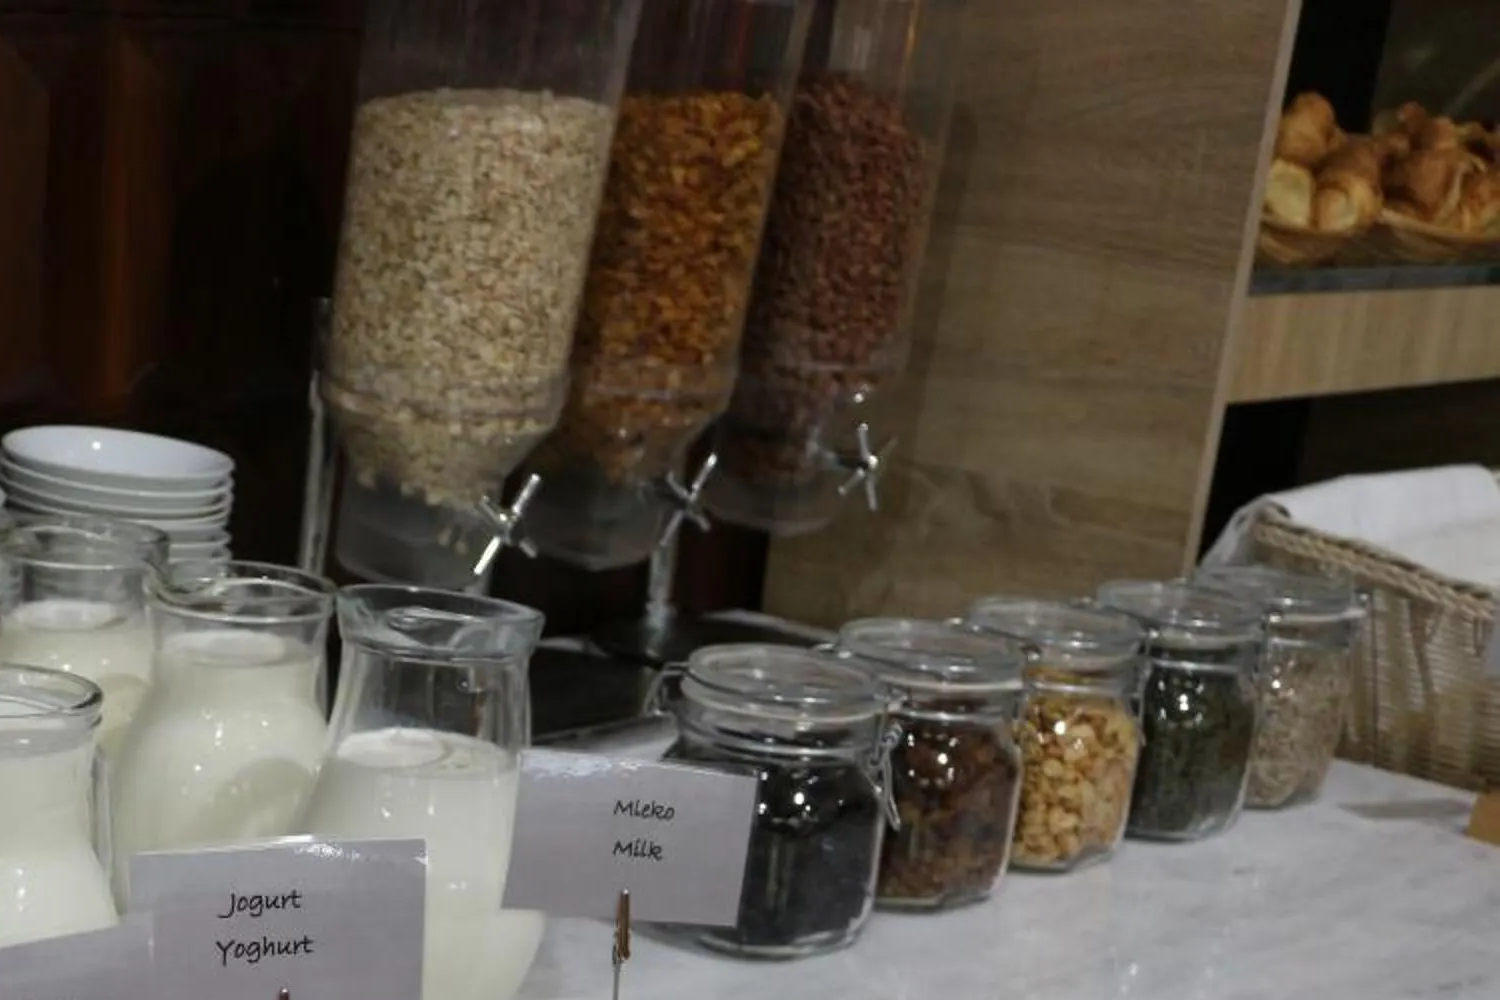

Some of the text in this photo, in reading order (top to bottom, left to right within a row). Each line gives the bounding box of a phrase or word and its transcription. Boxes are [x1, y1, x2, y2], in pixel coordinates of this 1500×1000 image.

[613, 799, 675, 821] Mleko
[612, 838, 663, 861] Milk
[217, 889, 302, 918] Jogurt
[215, 935, 314, 967] Yoghurt
